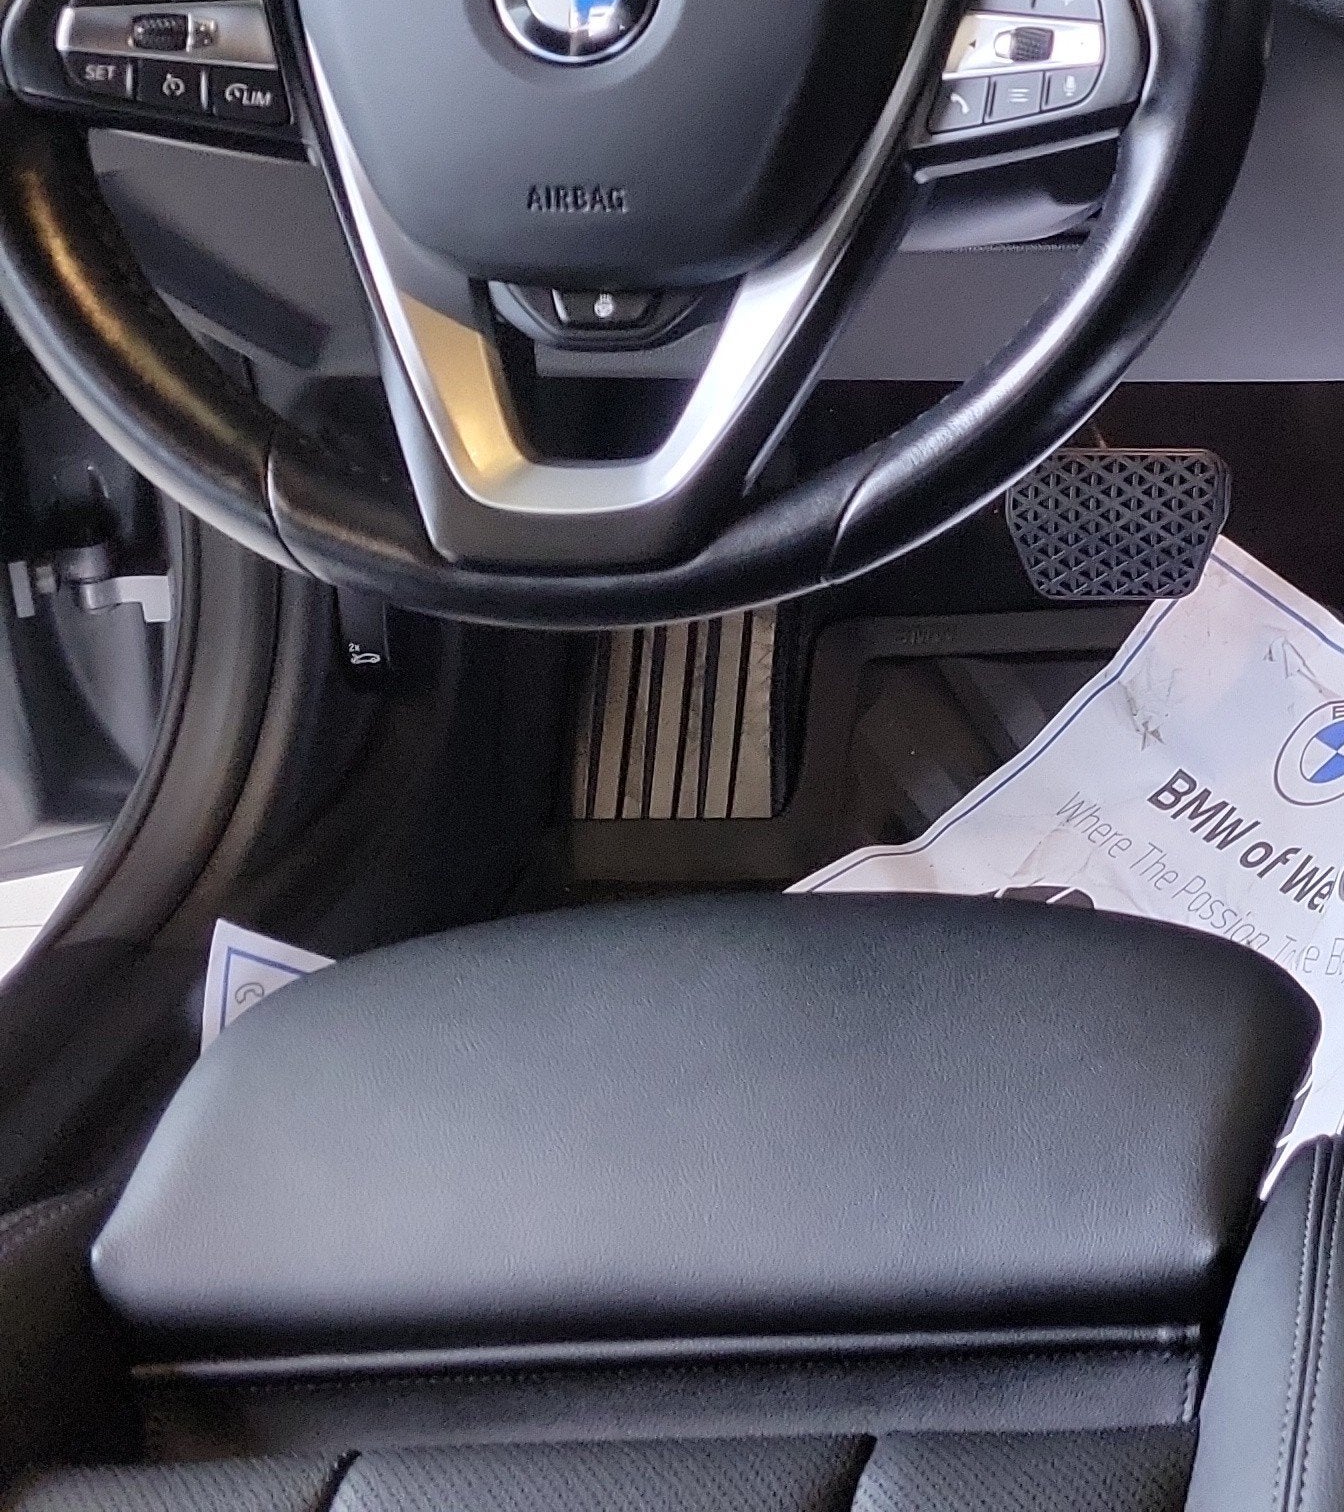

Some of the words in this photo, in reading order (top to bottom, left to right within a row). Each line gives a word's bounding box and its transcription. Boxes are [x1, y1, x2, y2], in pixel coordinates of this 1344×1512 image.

[84, 64, 117, 81] SET
[242, 90, 272, 107] LIM
[526, 185, 630, 214] AIRBAG
[1147, 768, 1261, 851] BMW
[1239, 841, 1302, 879] of
[1056, 791, 1133, 859] Where
[1130, 841, 1179, 891] The
[1171, 875, 1271, 951] Passion
